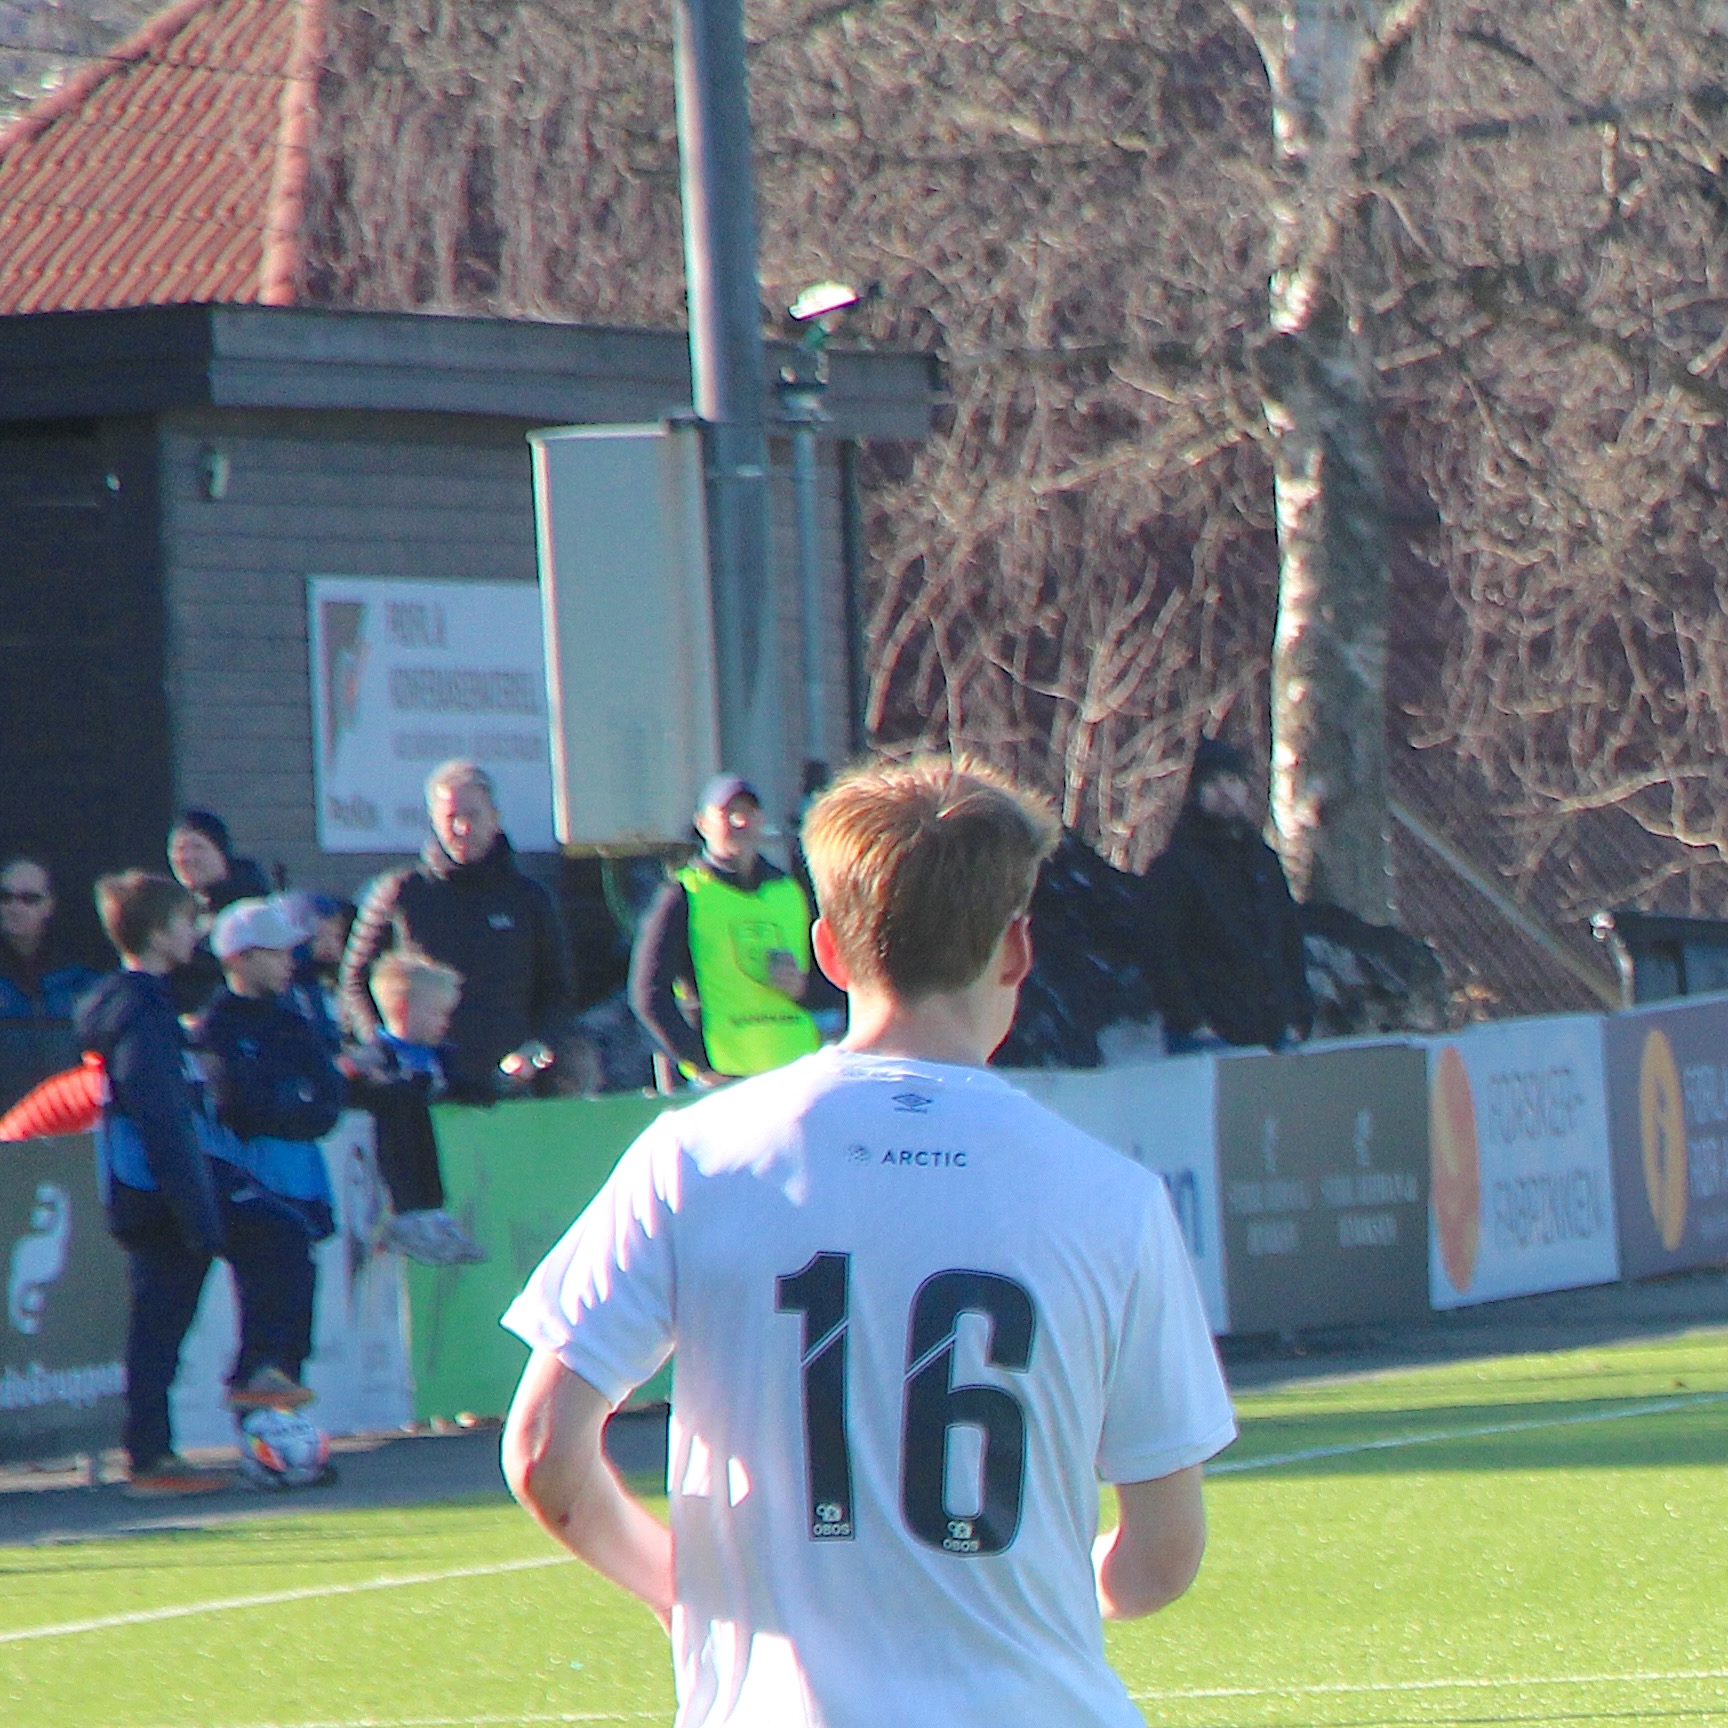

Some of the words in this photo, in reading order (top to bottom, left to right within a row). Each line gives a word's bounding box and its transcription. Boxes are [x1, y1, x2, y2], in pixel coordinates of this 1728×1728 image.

[880, 1150, 968, 1168] ARCTIC
[772, 1250, 1037, 1557] 16
[812, 1522, 851, 1536] OBOS
[942, 1538, 980, 1552] OBOS
